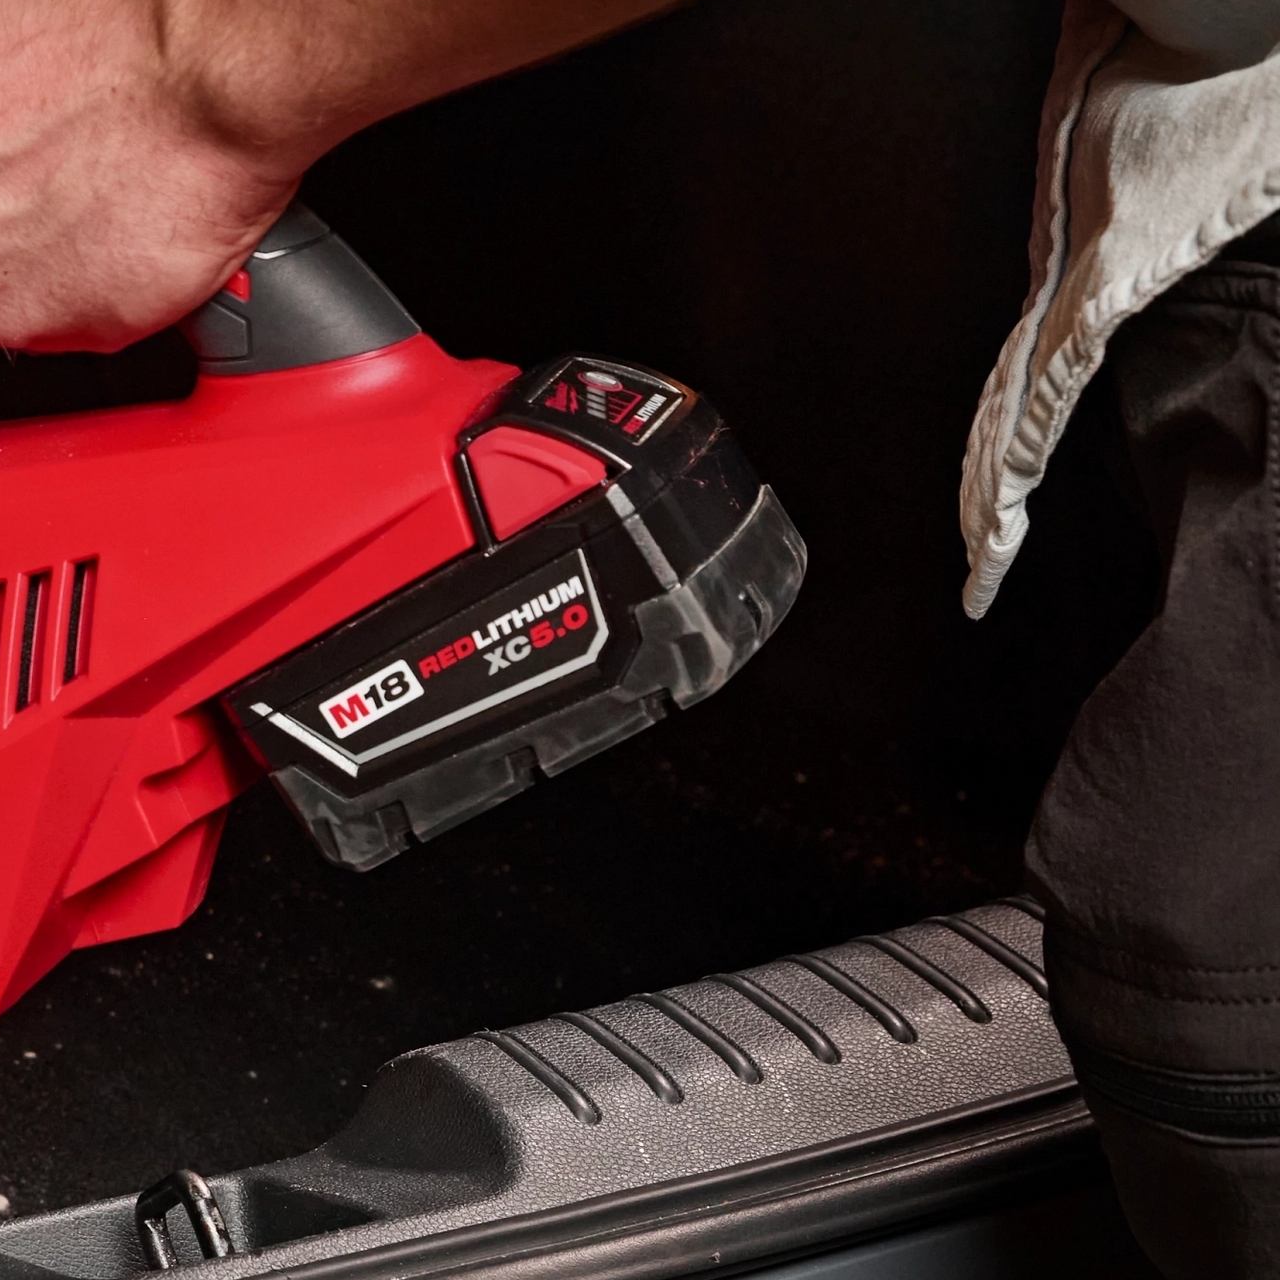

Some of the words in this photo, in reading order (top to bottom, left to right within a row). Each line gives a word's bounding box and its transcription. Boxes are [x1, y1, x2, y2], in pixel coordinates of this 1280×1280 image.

[328, 671, 410, 729] M18
[418, 575, 585, 679] REDLITHIUM
[483, 604, 588, 676] XC5.0
